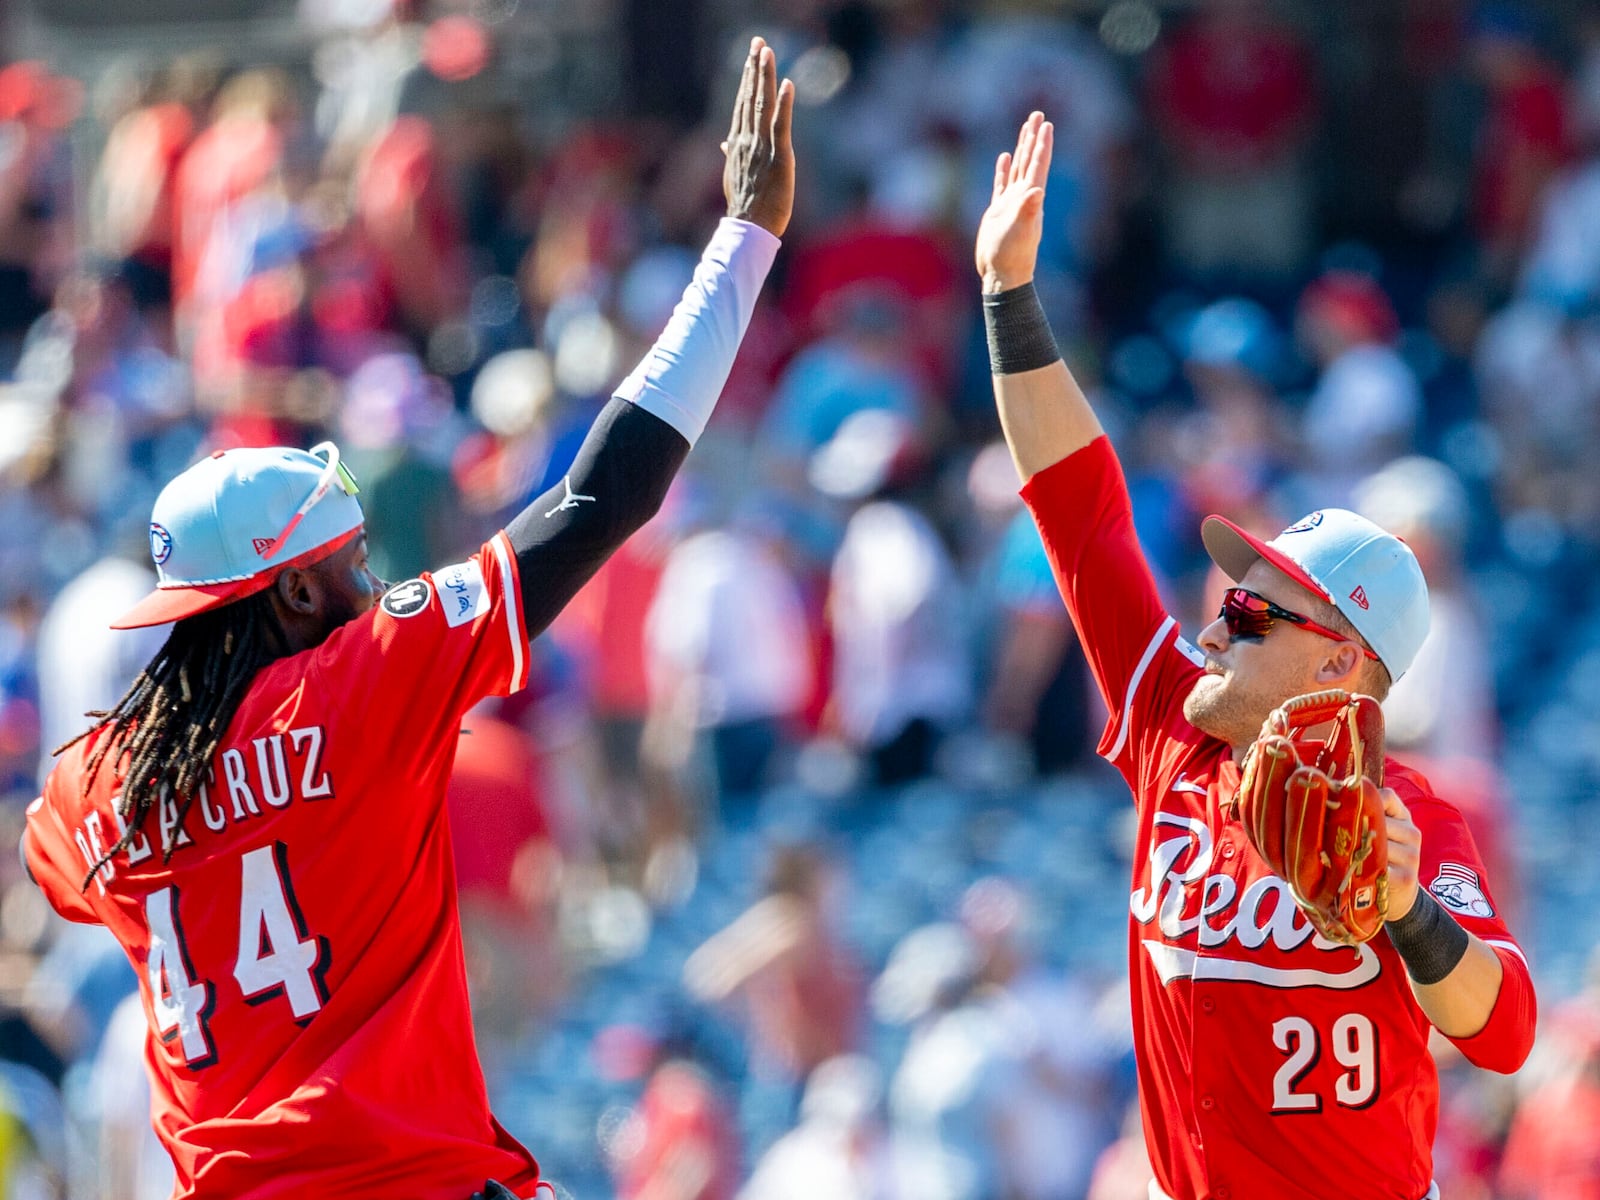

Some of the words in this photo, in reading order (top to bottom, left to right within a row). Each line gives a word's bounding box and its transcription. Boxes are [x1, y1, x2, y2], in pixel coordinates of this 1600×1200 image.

[389, 584, 423, 611] 14
[198, 726, 334, 832] CRUZ
[145, 841, 331, 1070] 44
[1270, 1012, 1380, 1115] 29
